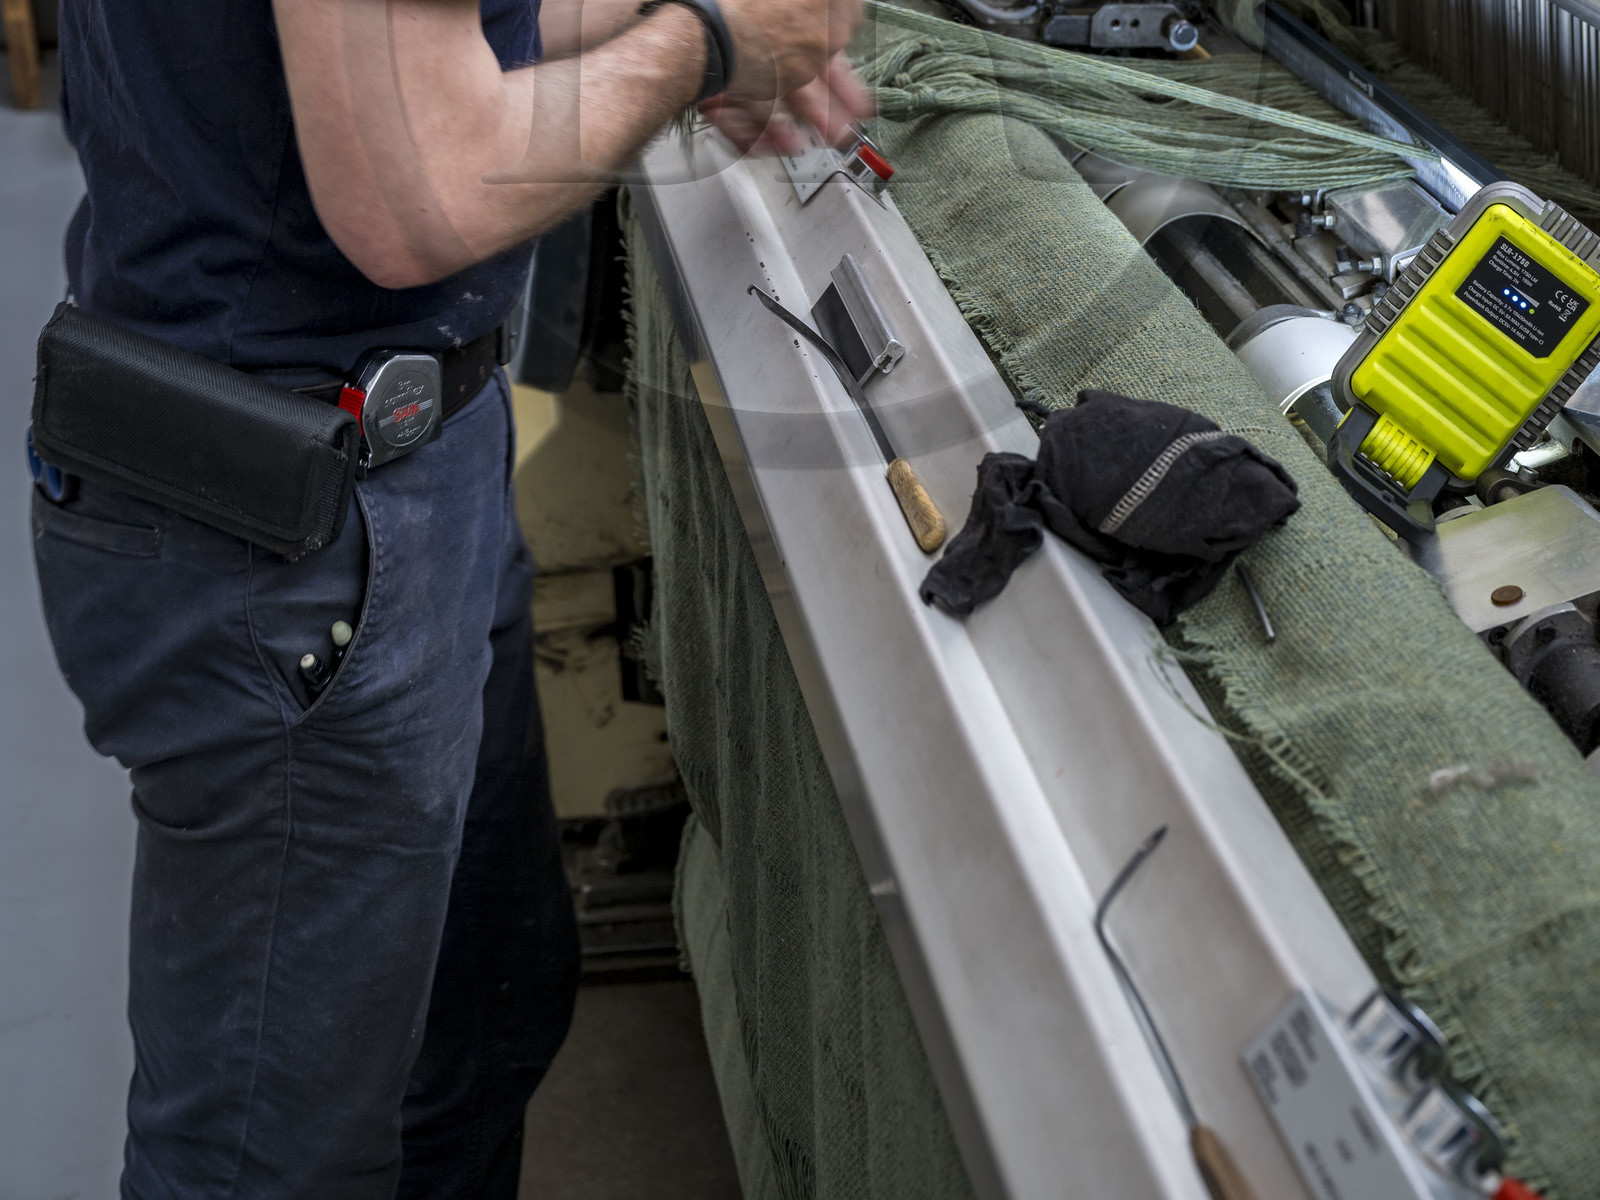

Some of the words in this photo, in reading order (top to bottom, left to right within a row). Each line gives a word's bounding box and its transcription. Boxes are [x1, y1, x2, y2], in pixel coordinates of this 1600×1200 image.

[1496, 250, 1505, 258] Max
[1521, 269, 1532, 278] 1750
[1500, 243, 1530, 267] SLR-1750
[1489, 260, 1502, 272] Charge
[1502, 270, 1512, 280] Time:
[1473, 280, 1487, 293] Battery
[1555, 290, 1568, 303] CE
[1464, 291, 1485, 309] Powerbank
[1516, 331, 1526, 340] MAX
[1468, 286, 1482, 298] Charge
[1510, 318, 1520, 326] MAX
[393, 401, 421, 423] SAM
